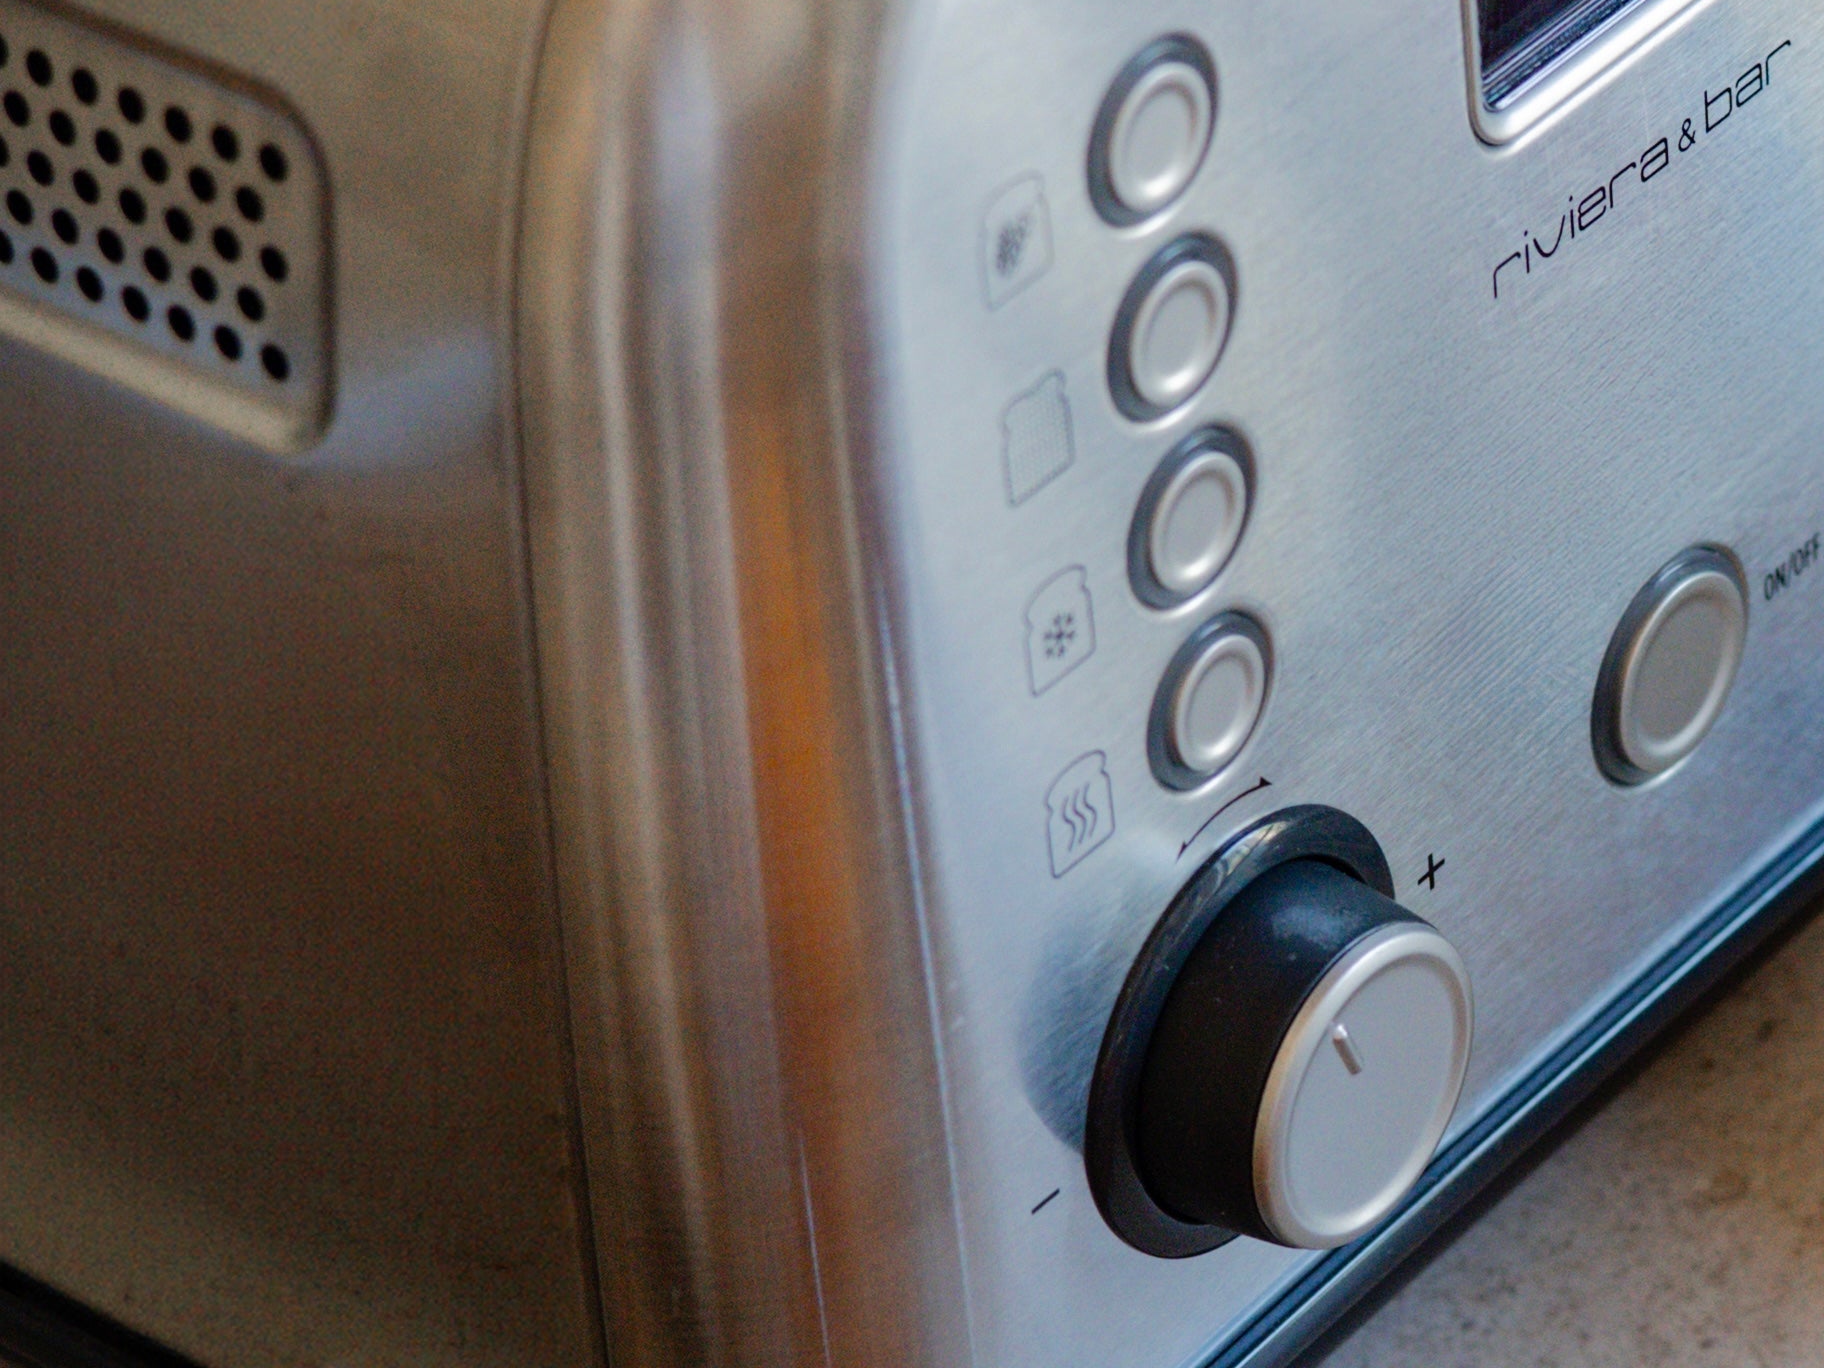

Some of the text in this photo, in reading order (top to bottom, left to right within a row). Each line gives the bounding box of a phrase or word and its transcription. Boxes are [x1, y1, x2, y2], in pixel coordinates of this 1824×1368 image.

[1493, 38, 1792, 300] riviera & bar
[1764, 531, 1821, 601] ON/OFF
